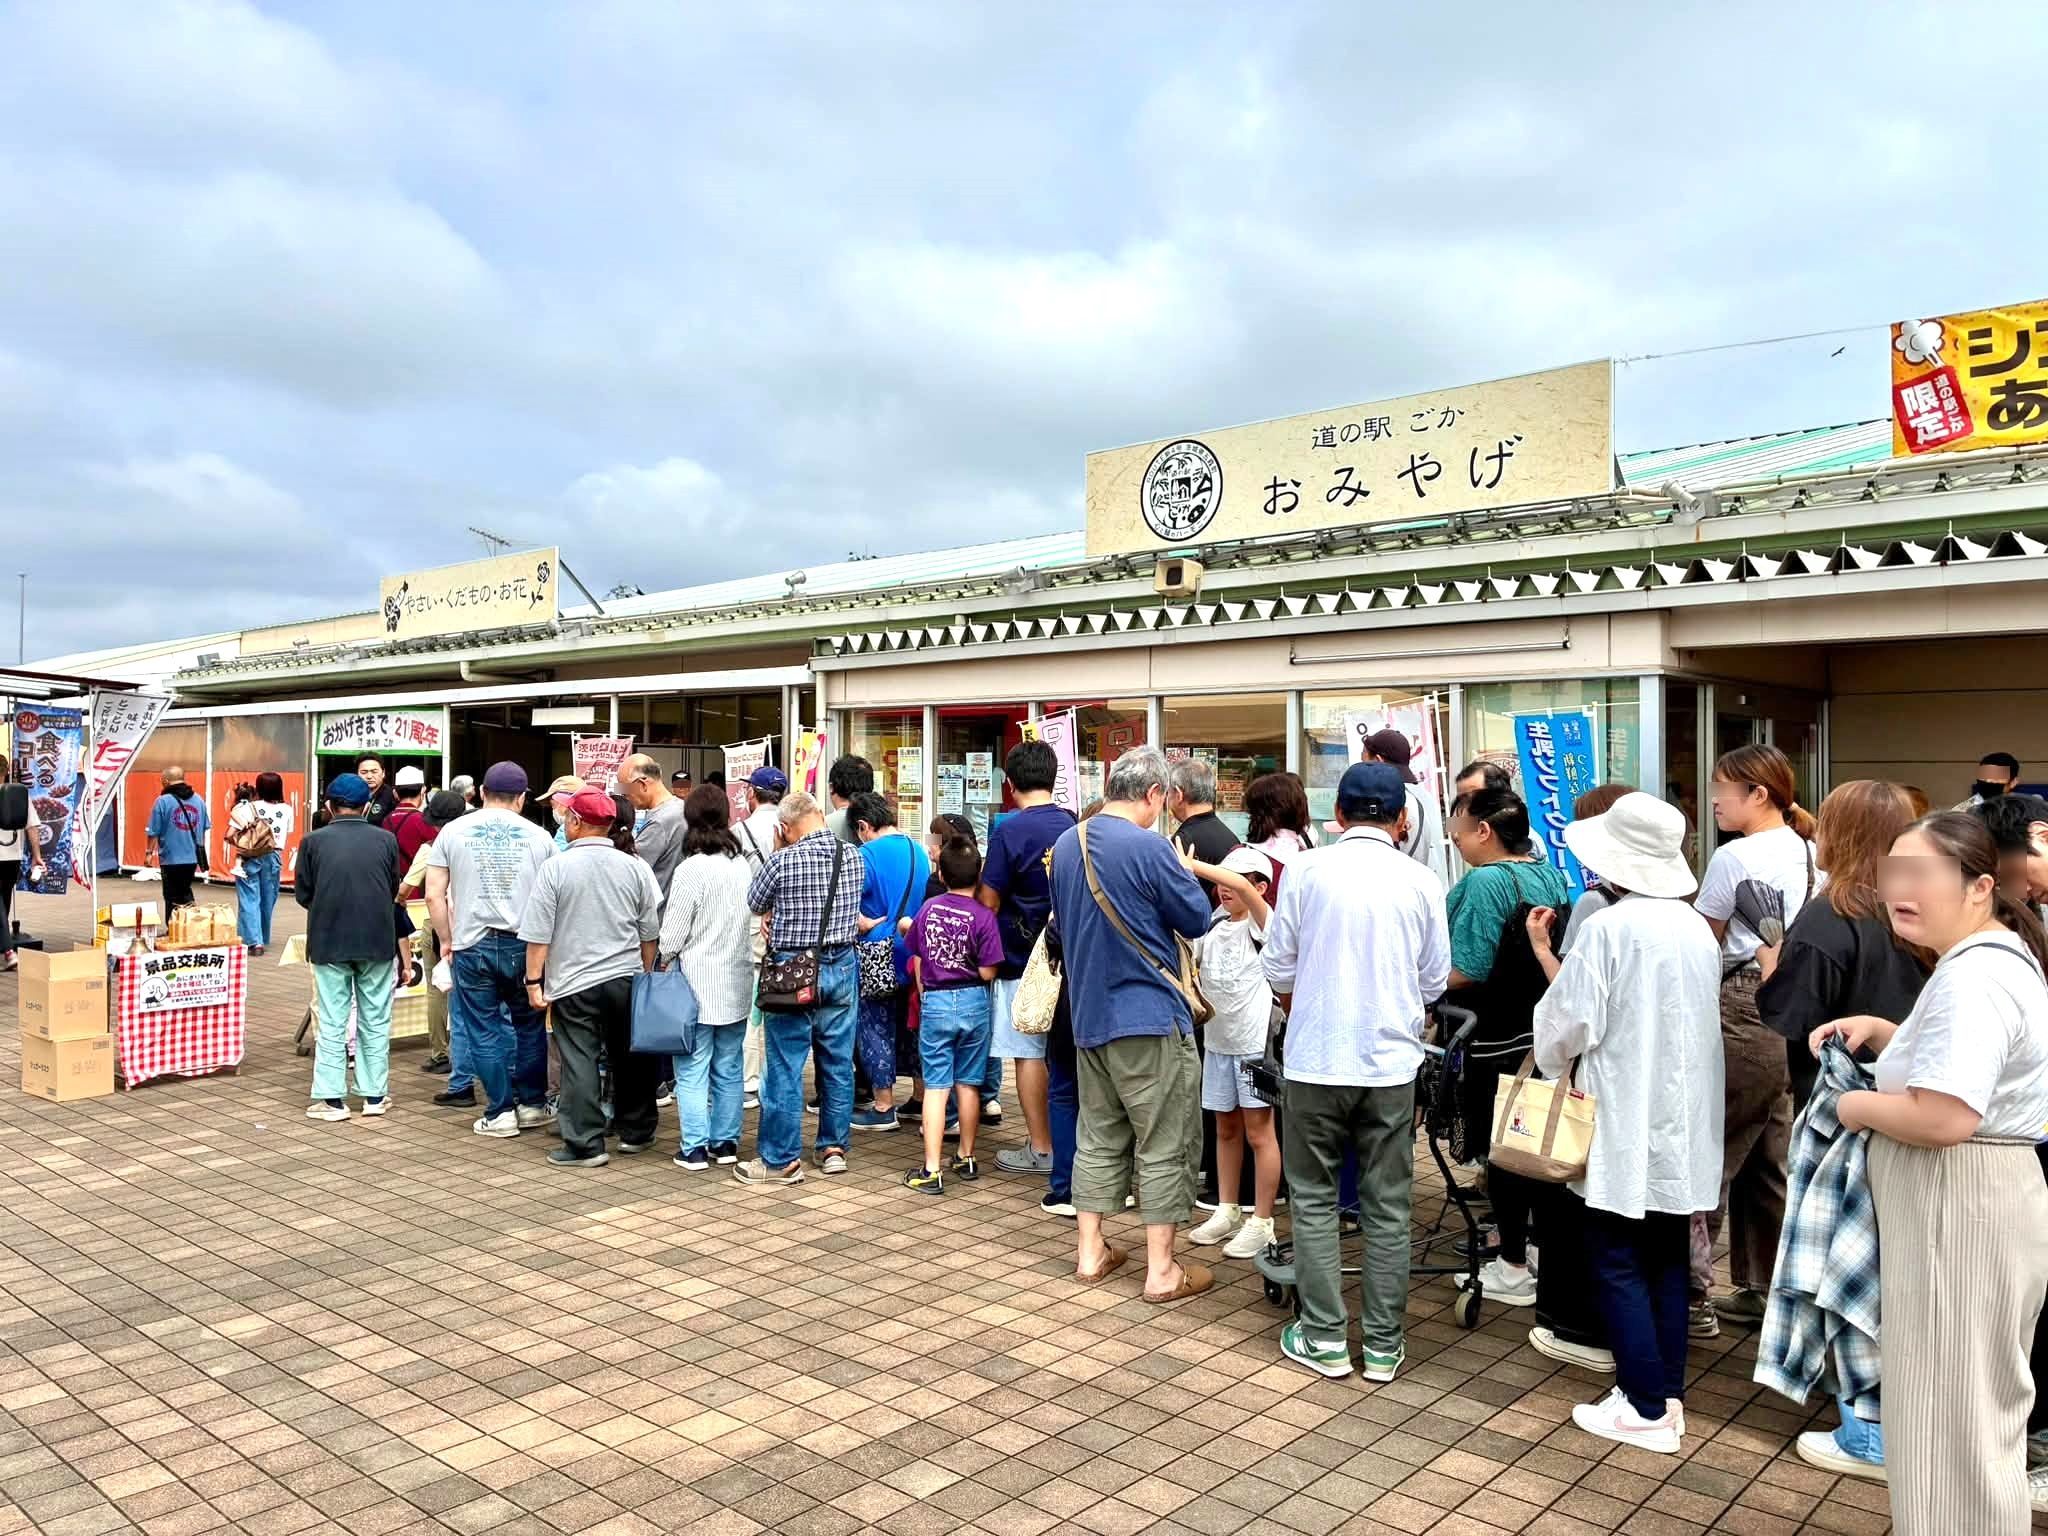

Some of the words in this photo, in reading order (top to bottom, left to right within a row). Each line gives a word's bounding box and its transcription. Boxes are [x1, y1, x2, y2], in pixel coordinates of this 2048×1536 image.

[1967, 319, 2048, 378] シ
[1311, 416, 1393, 450] 道の駅
[1409, 405, 1465, 433] ごか
[1900, 380, 1949, 445] 限定
[1263, 435, 1524, 515] おみやげ
[404, 578, 527, 614] やさい・くだもの・お花
[322, 714, 389, 747] おかげさまで
[395, 717, 439, 748] 21周年
[36, 731, 64, 787] 食べる
[145, 953, 225, 976] 景品交換所
